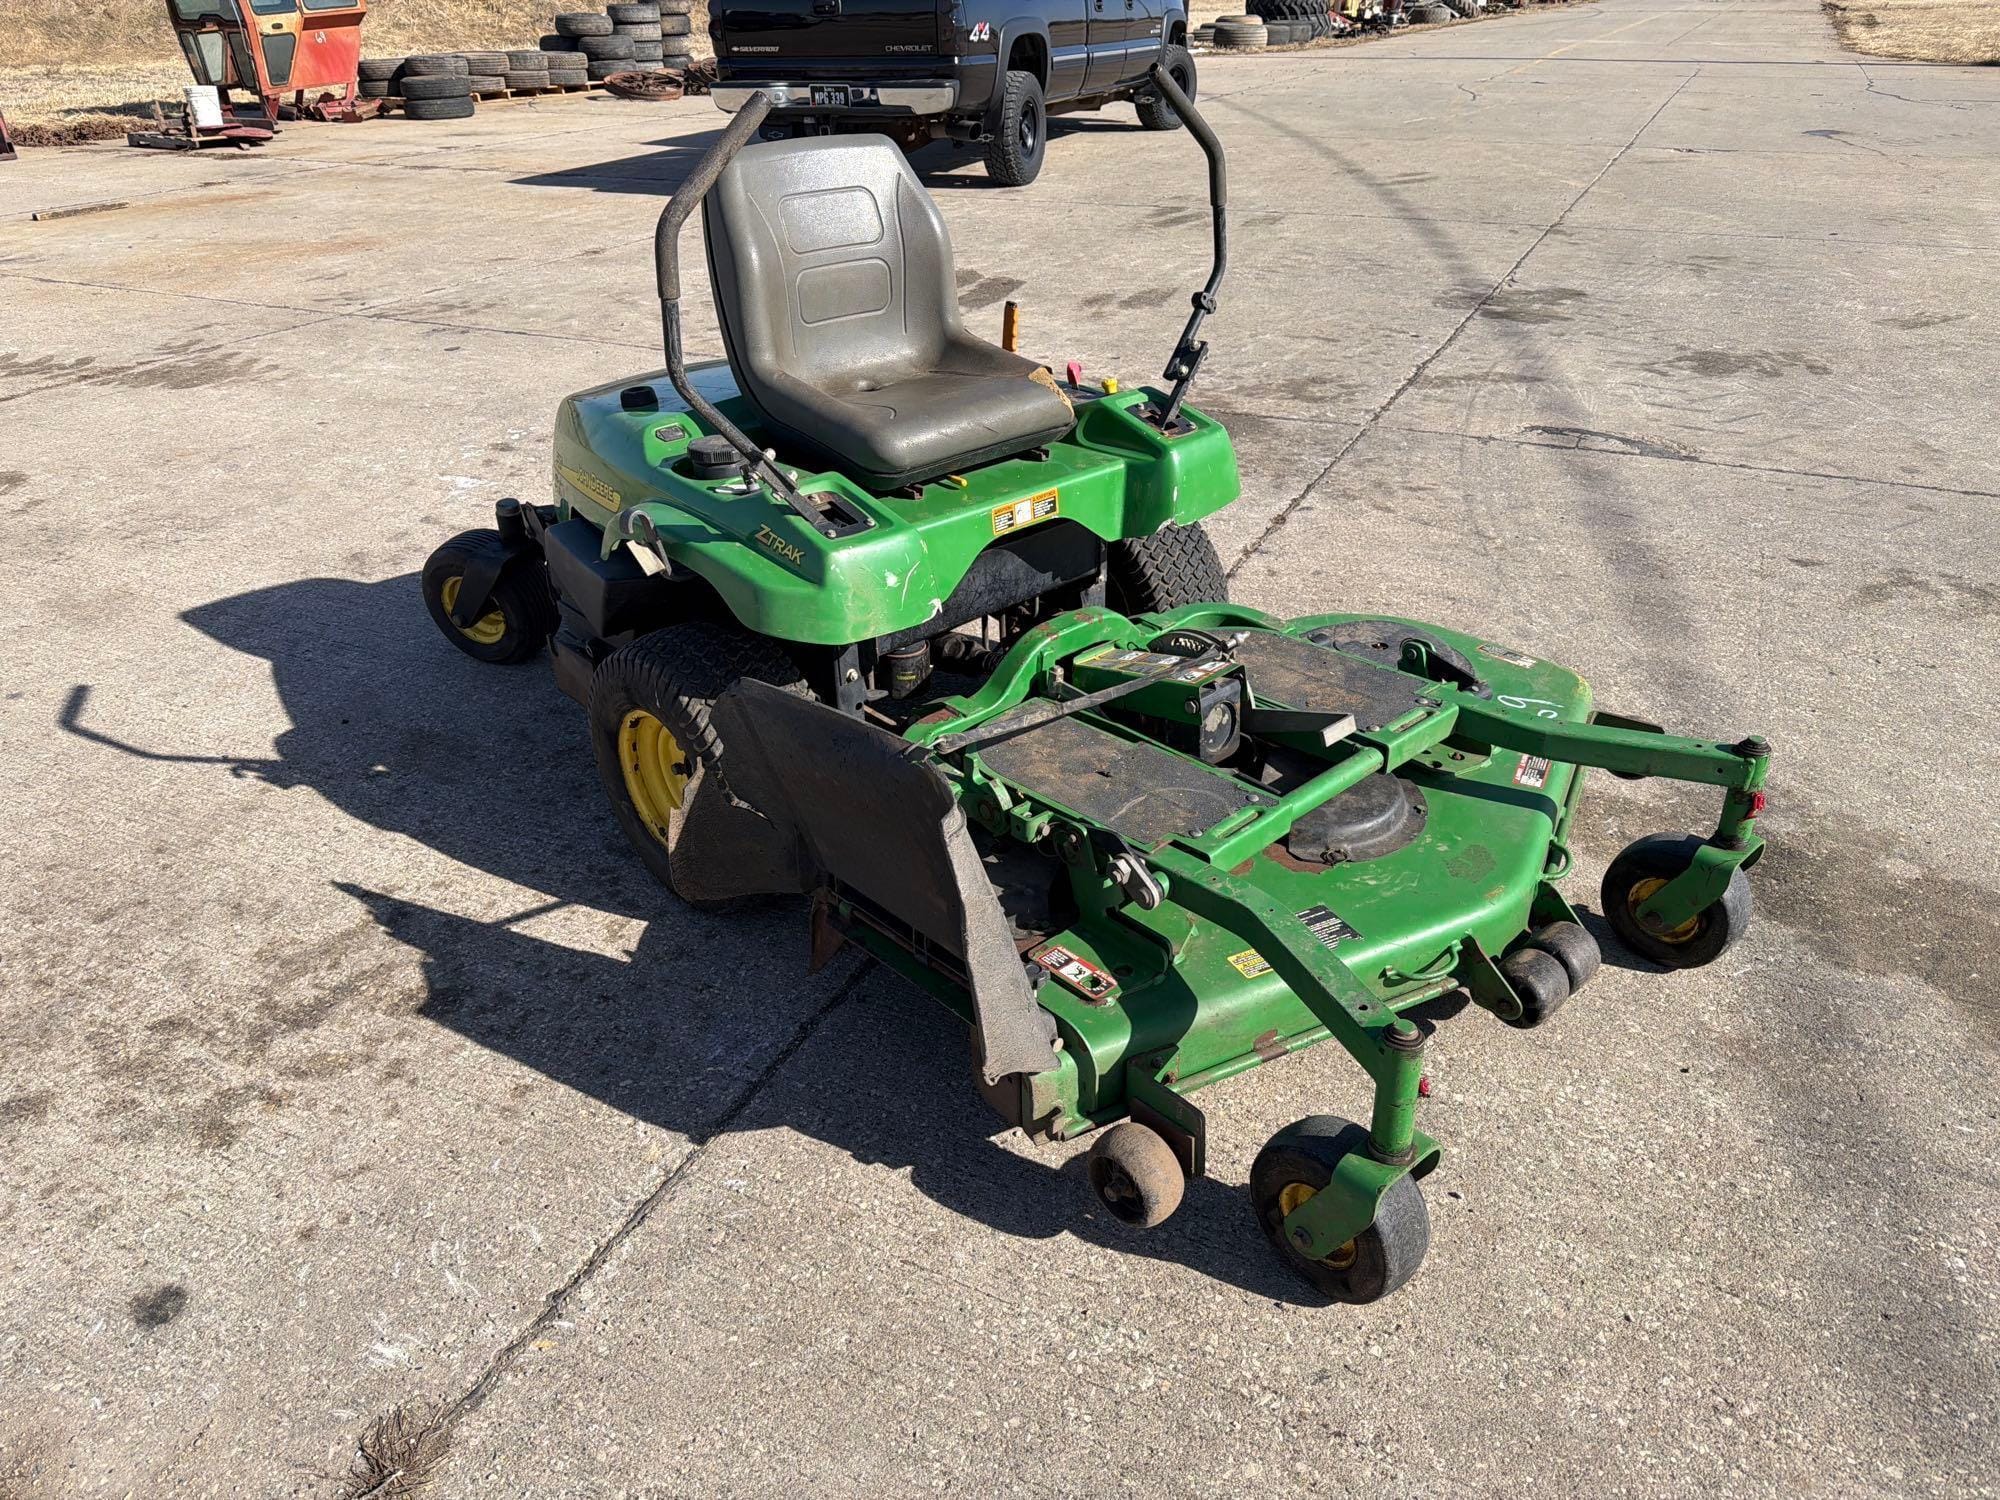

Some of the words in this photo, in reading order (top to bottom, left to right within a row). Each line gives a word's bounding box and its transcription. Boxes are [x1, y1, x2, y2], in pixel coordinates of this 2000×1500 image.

[884, 44, 933, 52] CHEVROLET
[830, 91, 845, 104] 339
[590, 473, 615, 503] DEERE
